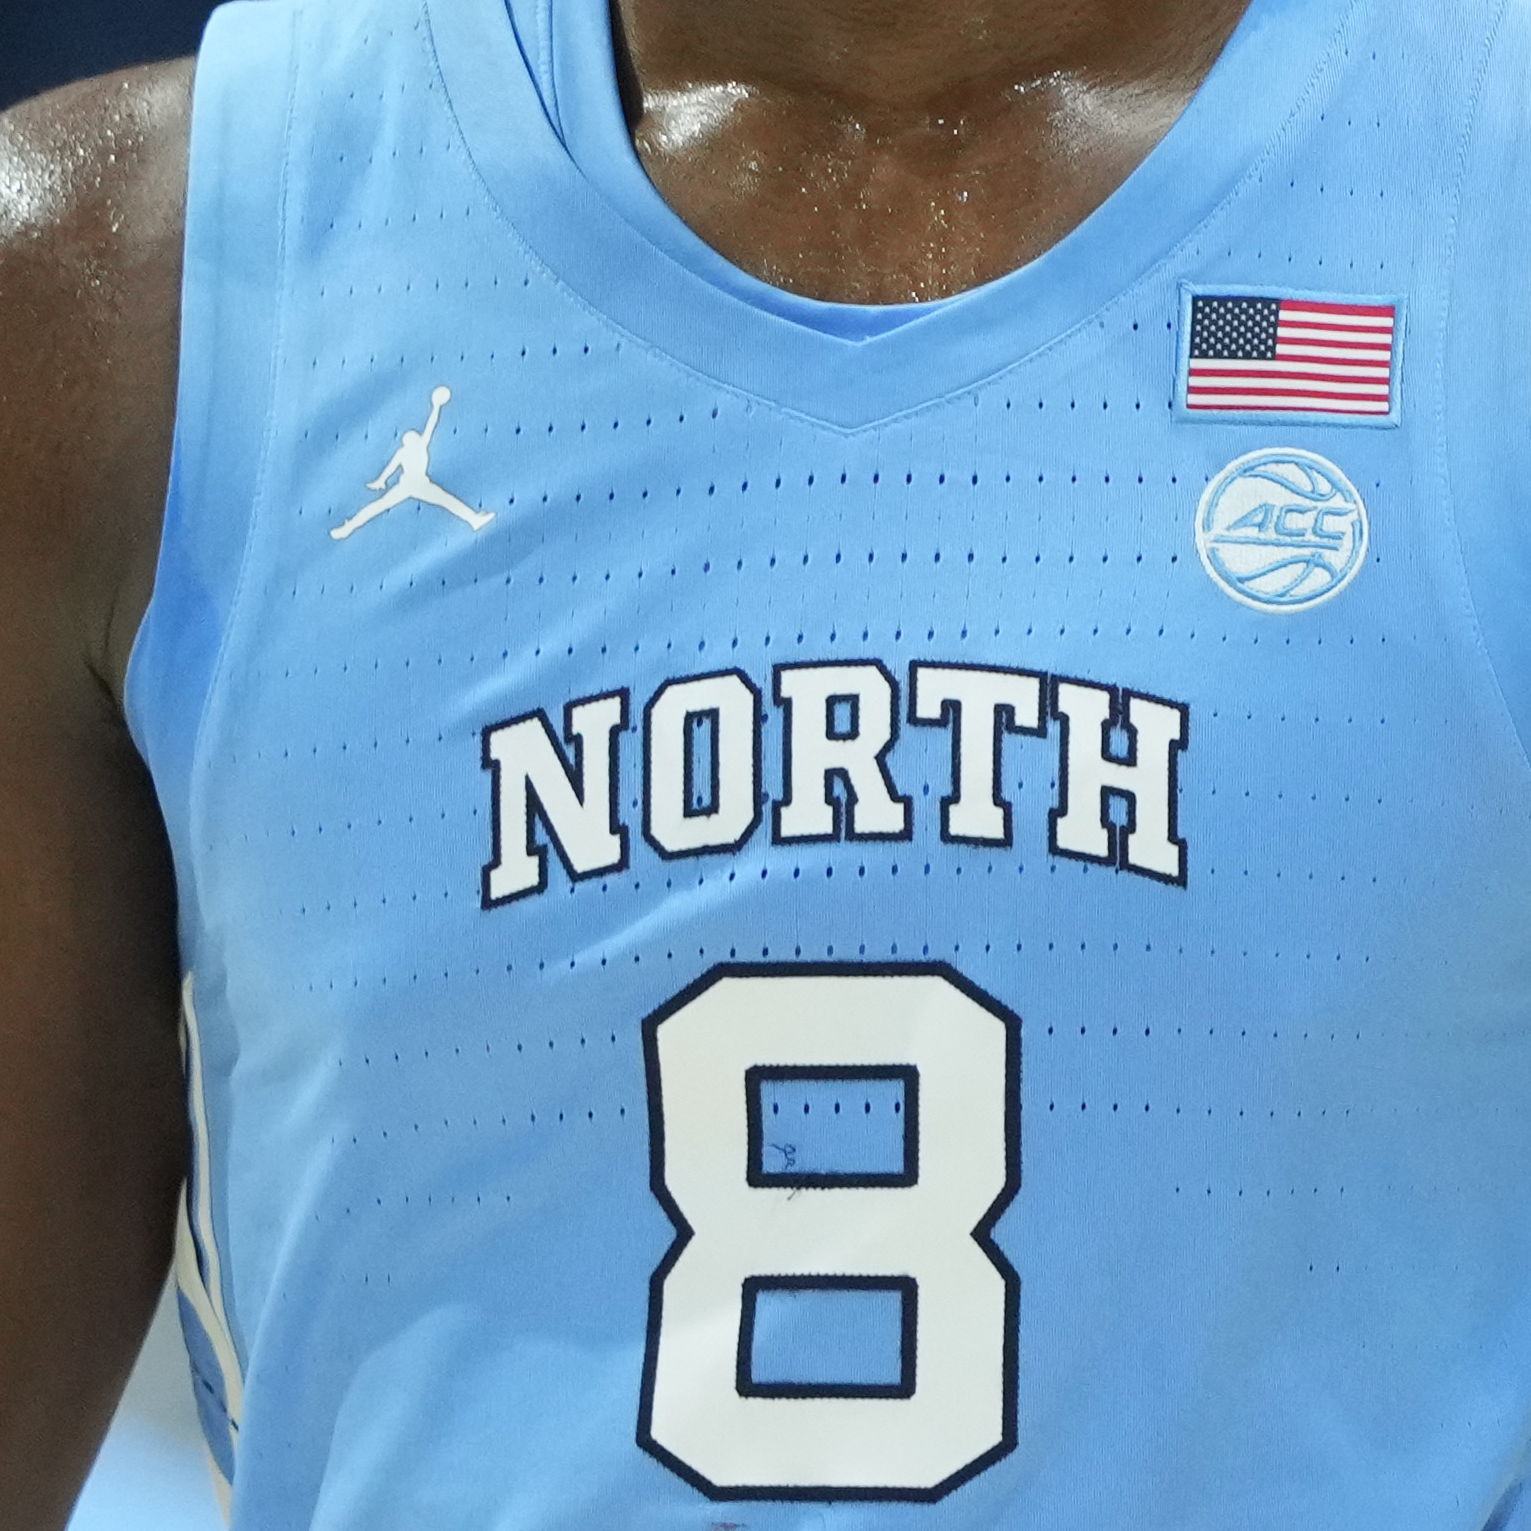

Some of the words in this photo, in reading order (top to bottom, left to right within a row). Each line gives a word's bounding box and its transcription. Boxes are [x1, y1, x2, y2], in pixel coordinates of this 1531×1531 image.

[1227, 502, 1357, 540] ACC
[481, 658, 1188, 910] NORTH
[636, 961, 1022, 1503] 8
